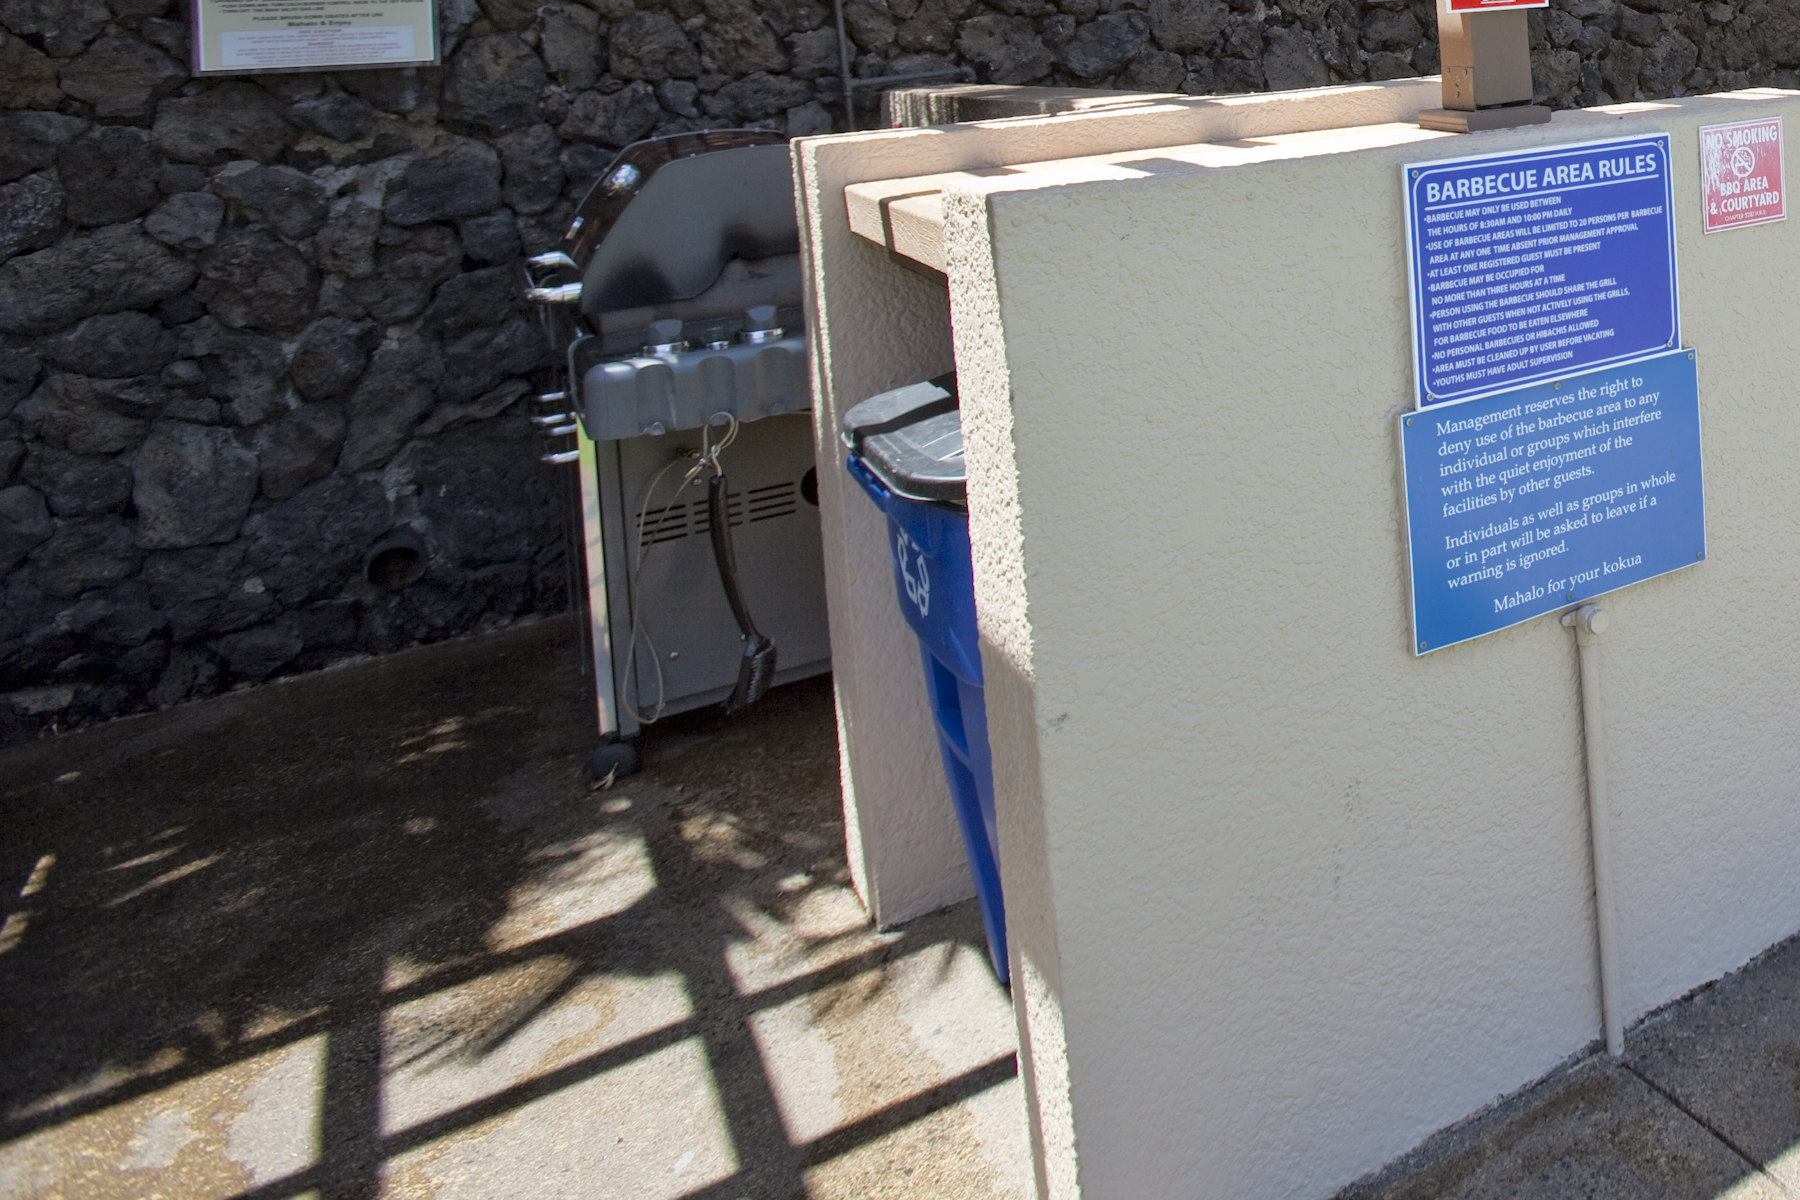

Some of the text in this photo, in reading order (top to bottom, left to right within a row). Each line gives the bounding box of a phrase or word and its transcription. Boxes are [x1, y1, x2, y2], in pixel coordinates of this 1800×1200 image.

[1706, 125, 1778, 150] NO SMOKING
[1426, 153, 1656, 203] BARBECUE AREA RULES
[1710, 190, 1780, 216] & COURTYARD
[1720, 176, 1769, 197] BBQ AREA
[1427, 207, 1572, 237] THE HOURS OF 8:30AM AND 10:00 PM DAILY
[1469, 275, 1484, 285] MAY
[1485, 273, 1495, 282] BE
[1495, 267, 1530, 280] OCCUPIED
[1530, 264, 1545, 274] FOR
[1466, 369, 1486, 381] MUST
[1487, 364, 1506, 376] HAVE
[1506, 359, 1529, 372] ADULT
[1529, 350, 1573, 367] SUPERVISION
[1436, 377, 1643, 436] Management reserves the right to
[1438, 392, 1660, 456] deny use of the barbecue area to any
[1440, 410, 1662, 477] individual or groups which interfere
[1441, 435, 1633, 496] with the quiet enjoyment of the
[1443, 465, 1595, 517] facilities by other guests.
[1445, 471, 1676, 550] Individuals as well as groups in whole
[1447, 495, 1657, 569] or in part will be asked to leave if a
[1447, 540, 1569, 589] warning is ignored.
[1494, 555, 1642, 613] Mahalo for your kokua
